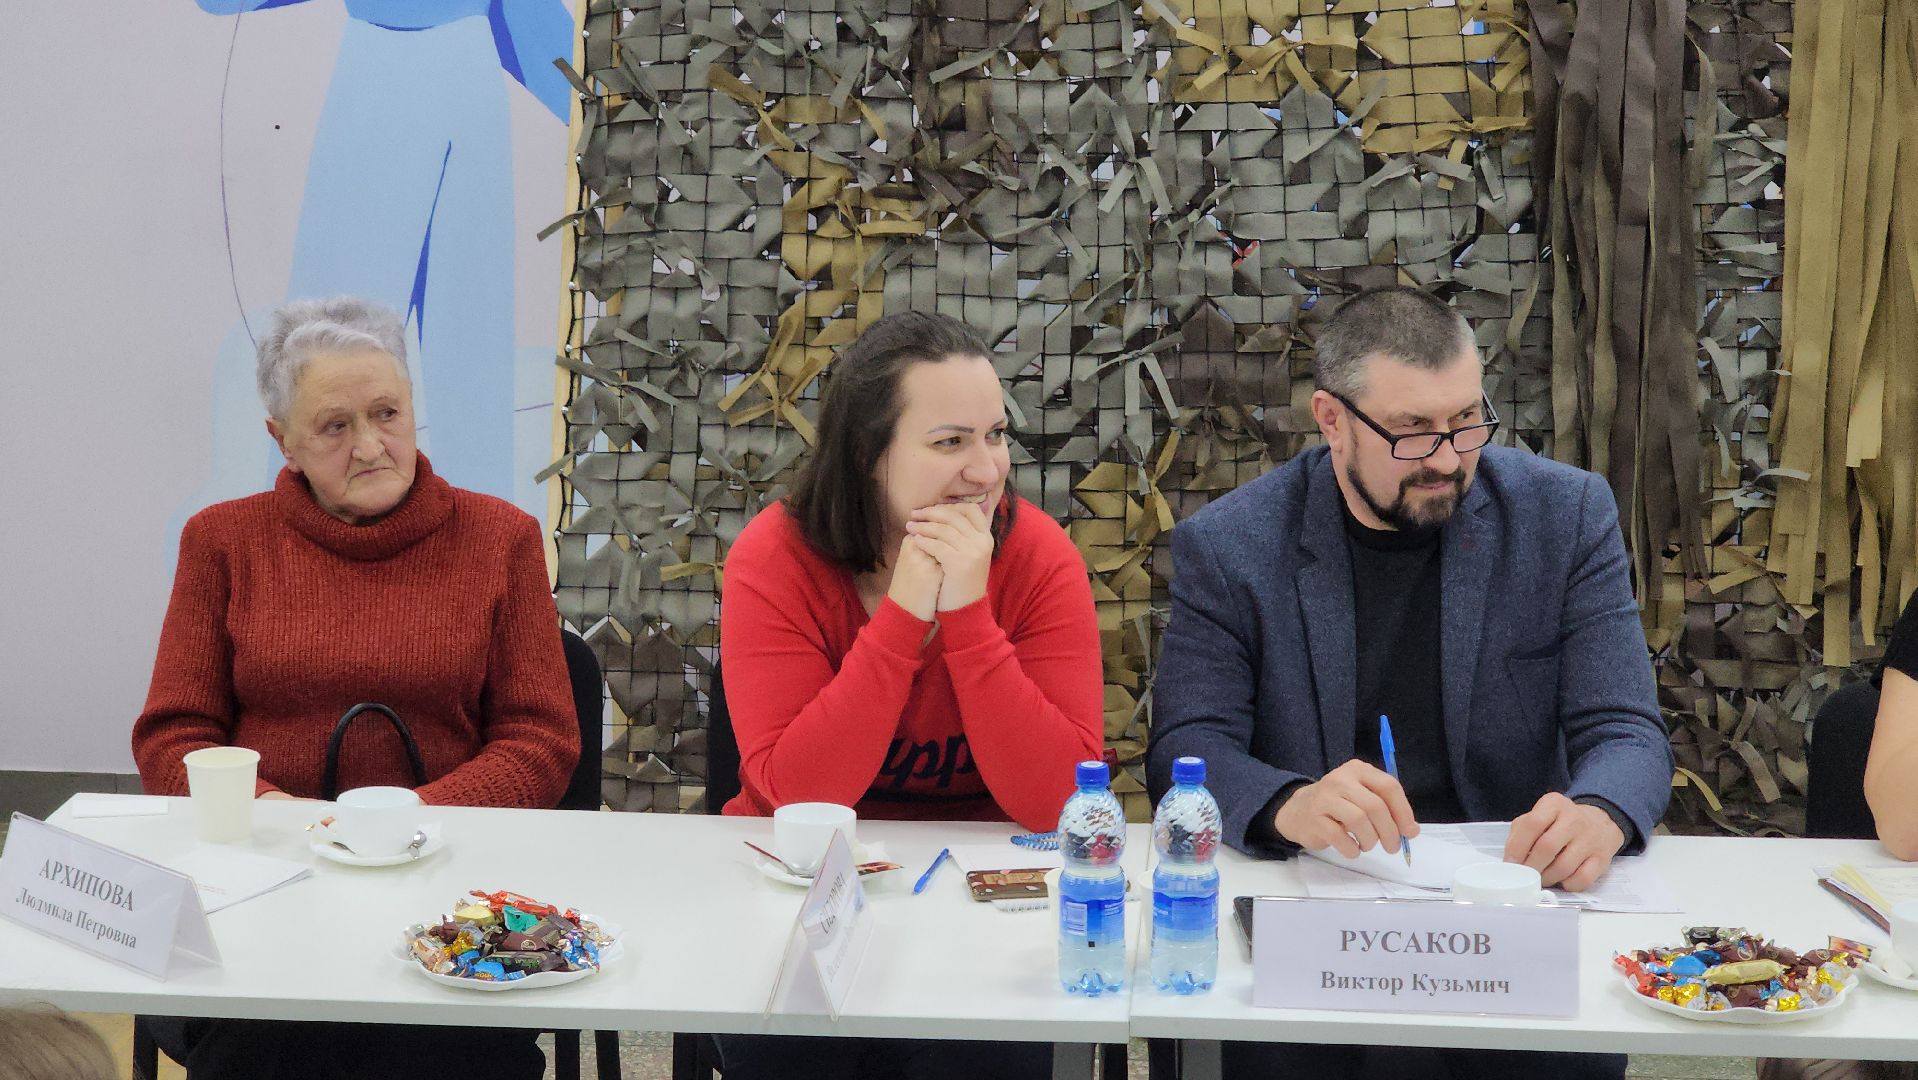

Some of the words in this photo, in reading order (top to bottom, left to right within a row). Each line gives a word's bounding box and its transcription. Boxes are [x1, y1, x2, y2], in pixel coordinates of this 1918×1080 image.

[39, 858, 134, 912] АРХИПОВА
[15, 887, 73, 923] Людмила
[75, 910, 137, 949] Петровна
[1340, 929, 1492, 955] РУСАКОВ
[1320, 970, 1404, 996] Виктор
[1412, 973, 1510, 997] Кузьмич
